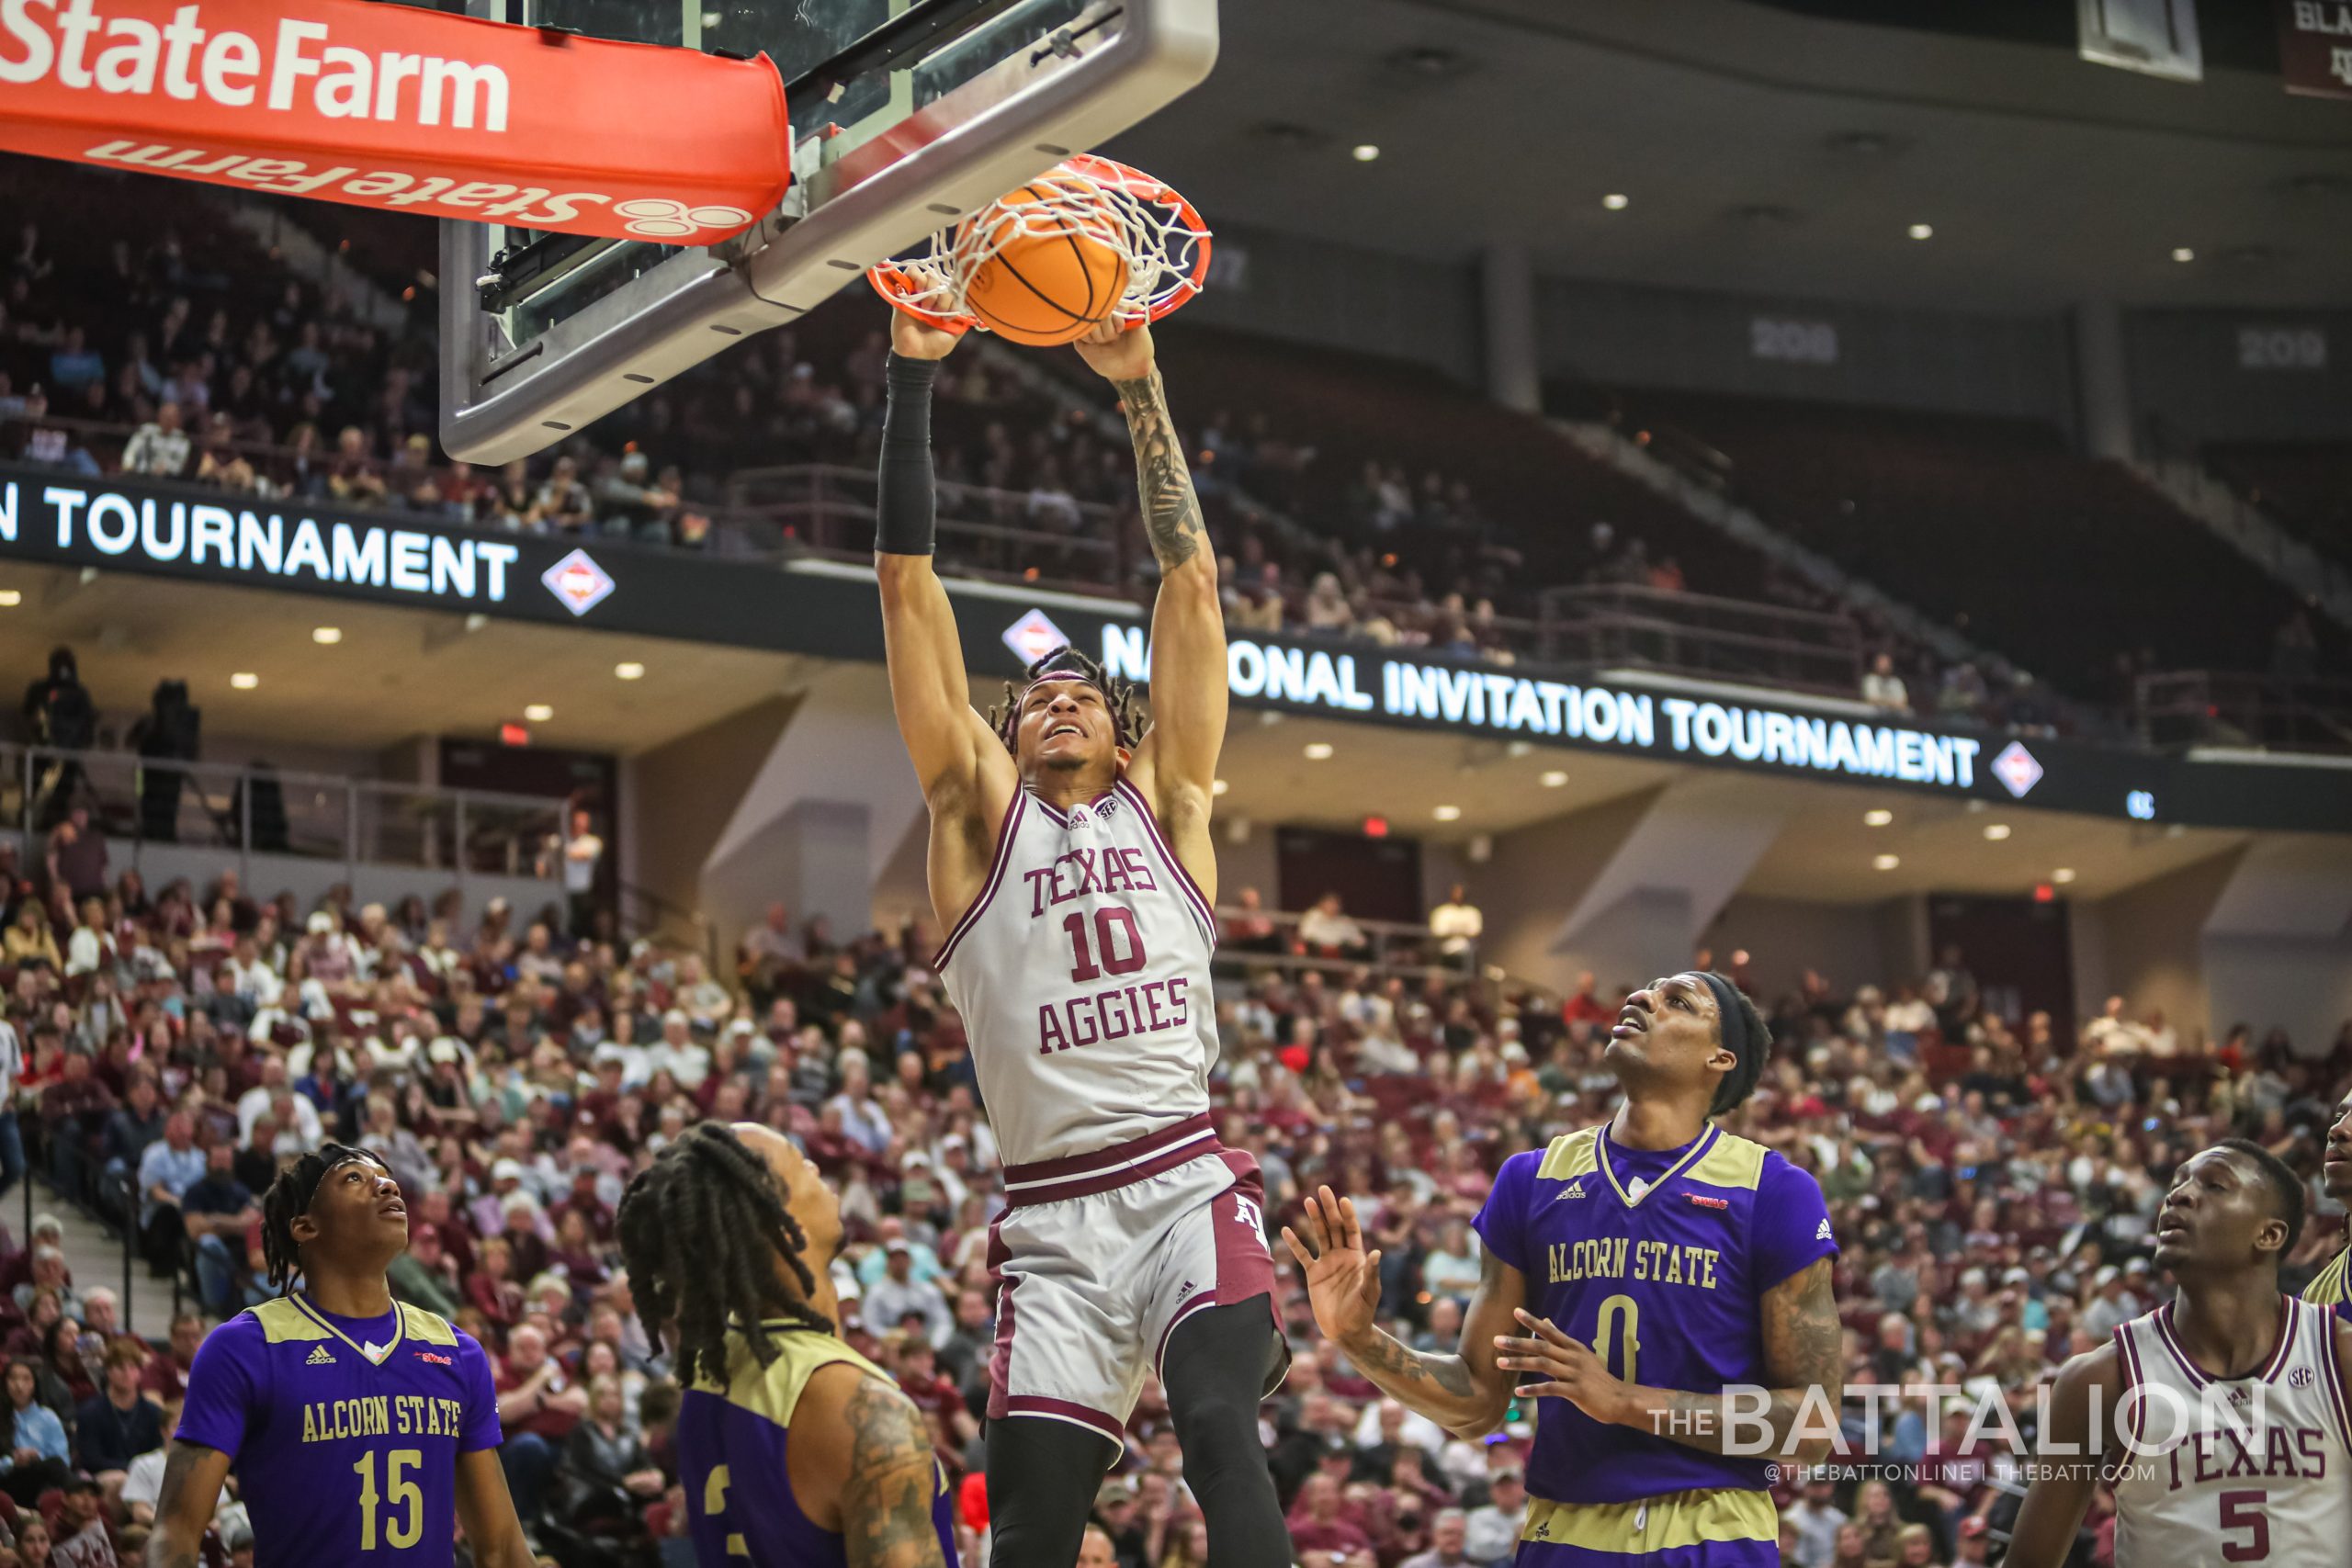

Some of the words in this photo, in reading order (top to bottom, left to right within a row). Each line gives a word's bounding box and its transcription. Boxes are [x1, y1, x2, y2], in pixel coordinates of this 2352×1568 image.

[43, 486, 519, 602] TOURNAMENT
[1101, 623, 1374, 712] NONAL
[1382, 660, 1655, 748] INVITATION
[1660, 697, 1981, 788] TOURNAMENT
[1100, 801, 1117, 818] SEC
[1023, 846, 1158, 919] TEXAS
[1062, 906, 1148, 983] 10
[1038, 977, 1190, 1055] AGGIES
[1691, 1195, 1729, 1210] SWAC
[1549, 1236, 1630, 1284] ALCORN
[1634, 1240, 1720, 1290] STATE
[305, 1355, 337, 1365] adidas
[2291, 1367, 2312, 1387] SEC
[301, 1394, 390, 1443] ALCORN
[2158, 1426, 2326, 1492] TEXAS
[353, 1449, 424, 1551] 15
[2219, 1489, 2270, 1562] 5
